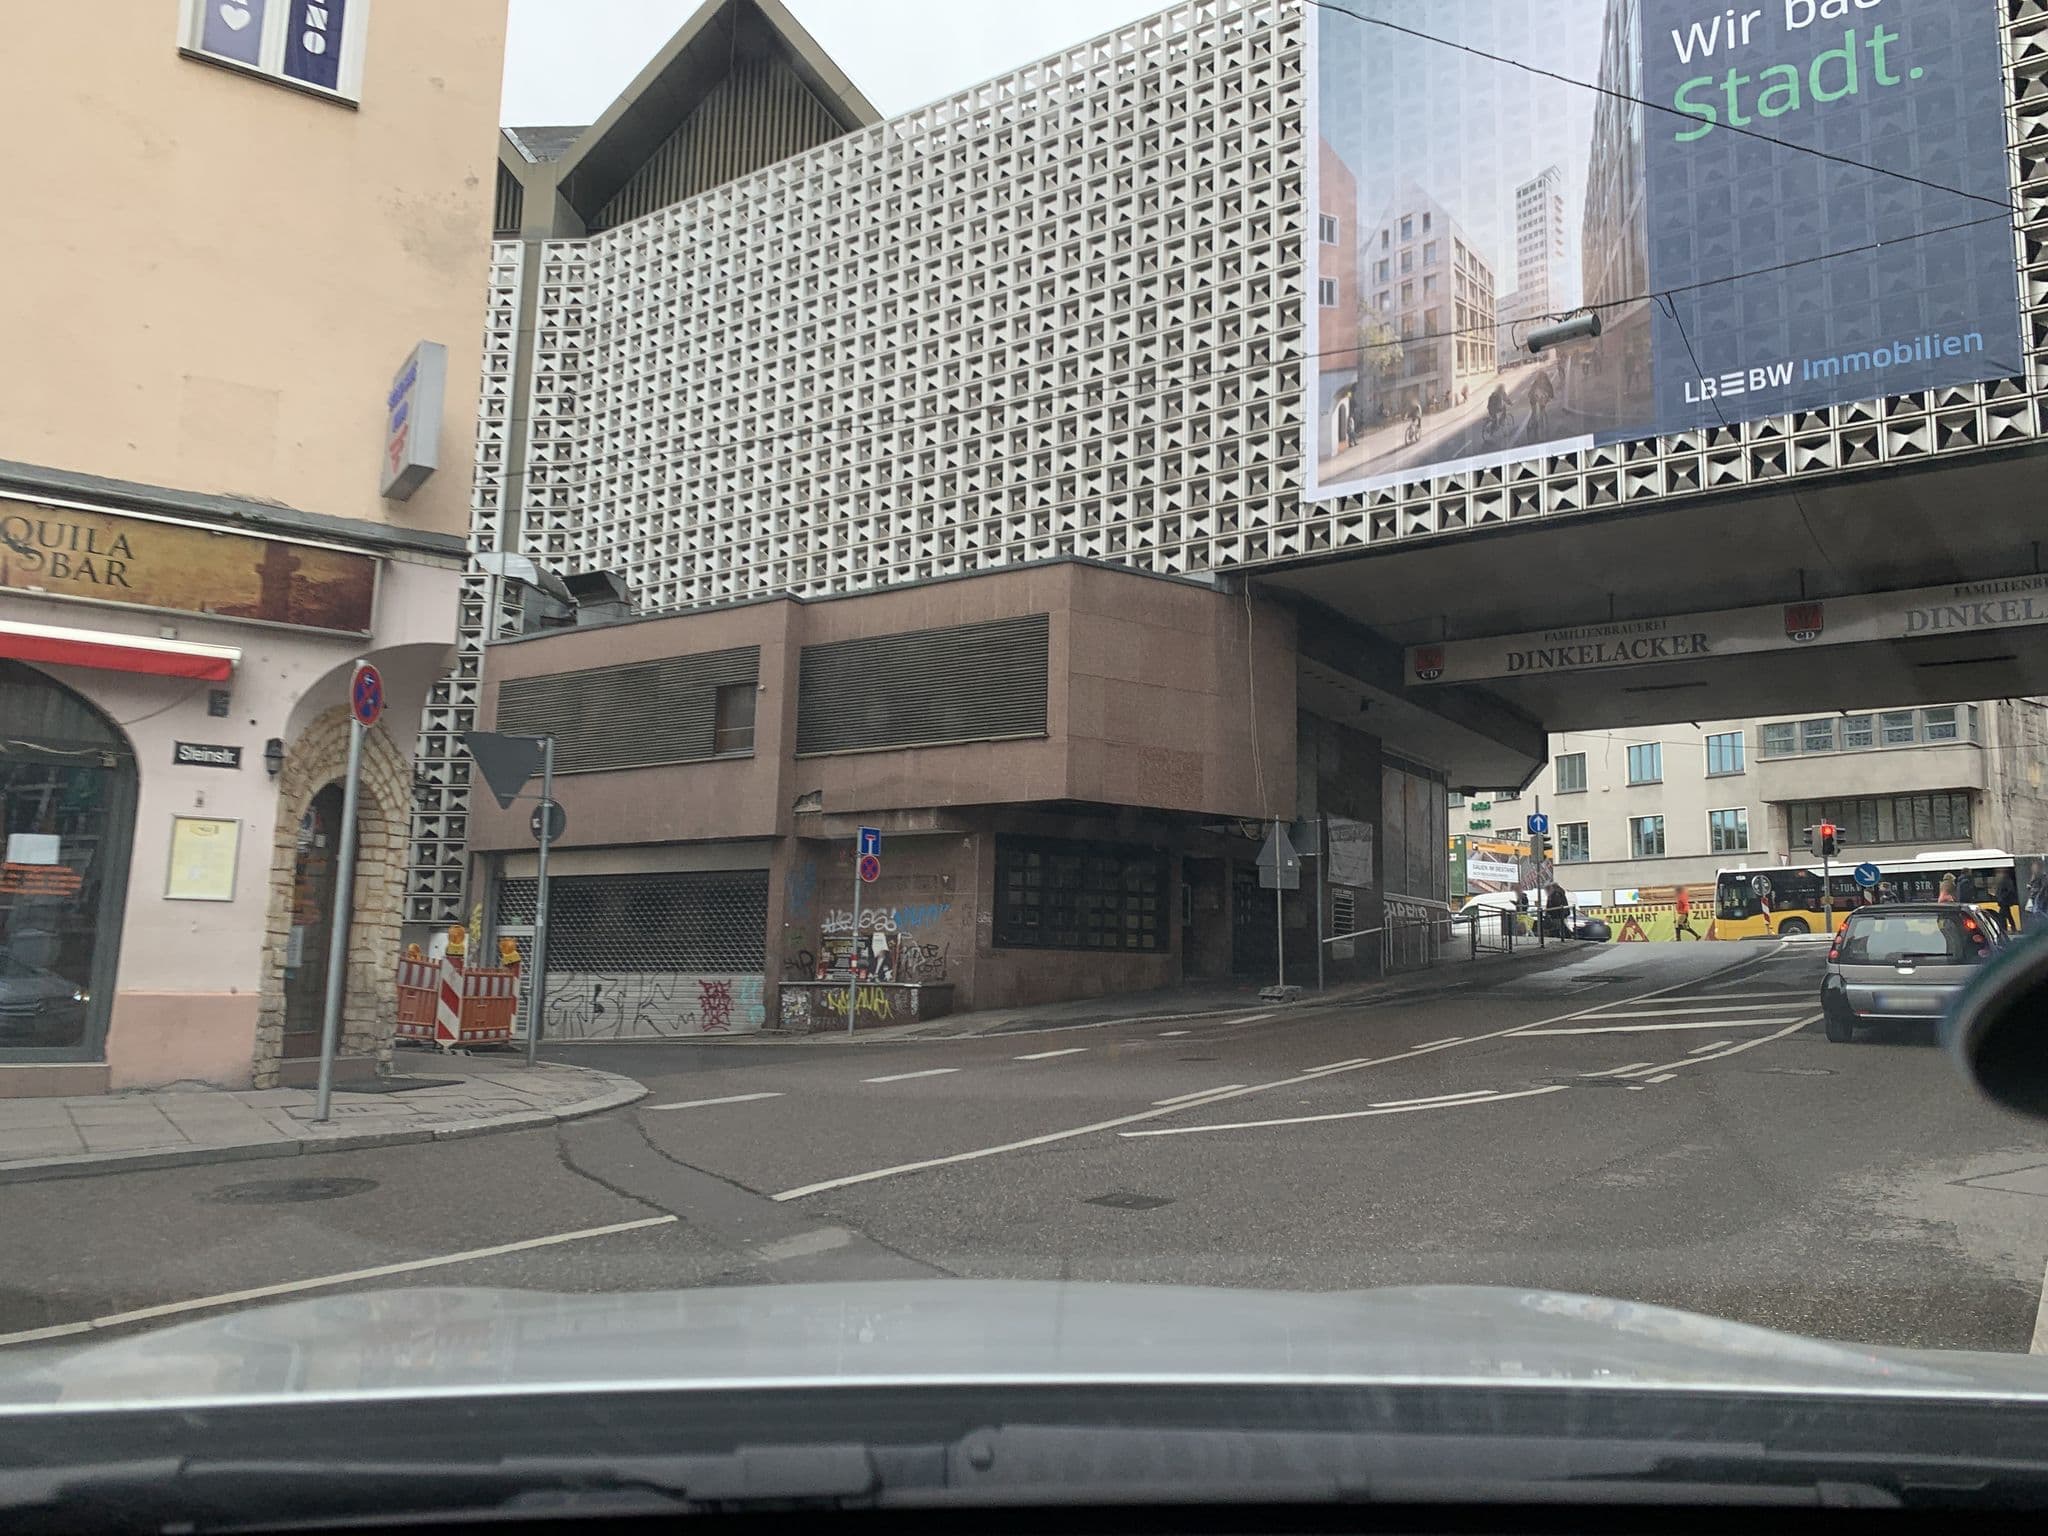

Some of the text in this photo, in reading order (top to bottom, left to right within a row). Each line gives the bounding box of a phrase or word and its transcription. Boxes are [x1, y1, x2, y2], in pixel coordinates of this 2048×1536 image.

[1671, 0, 1885, 64] Wir ba
[1674, 24, 1923, 141] Stadt.
[1803, 332, 1983, 380] Immobilien
[1904, 597, 2048, 632] DINKEL
[1544, 620, 1667, 641] FAMILIENBRAUEREI
[1794, 631, 1816, 641] CD
[1506, 633, 1711, 672] DINKELACKER
[1420, 669, 1438, 679] CD
[178, 744, 237, 765] Steinstr.
[1606, 912, 1658, 924] ZUFAHRT
